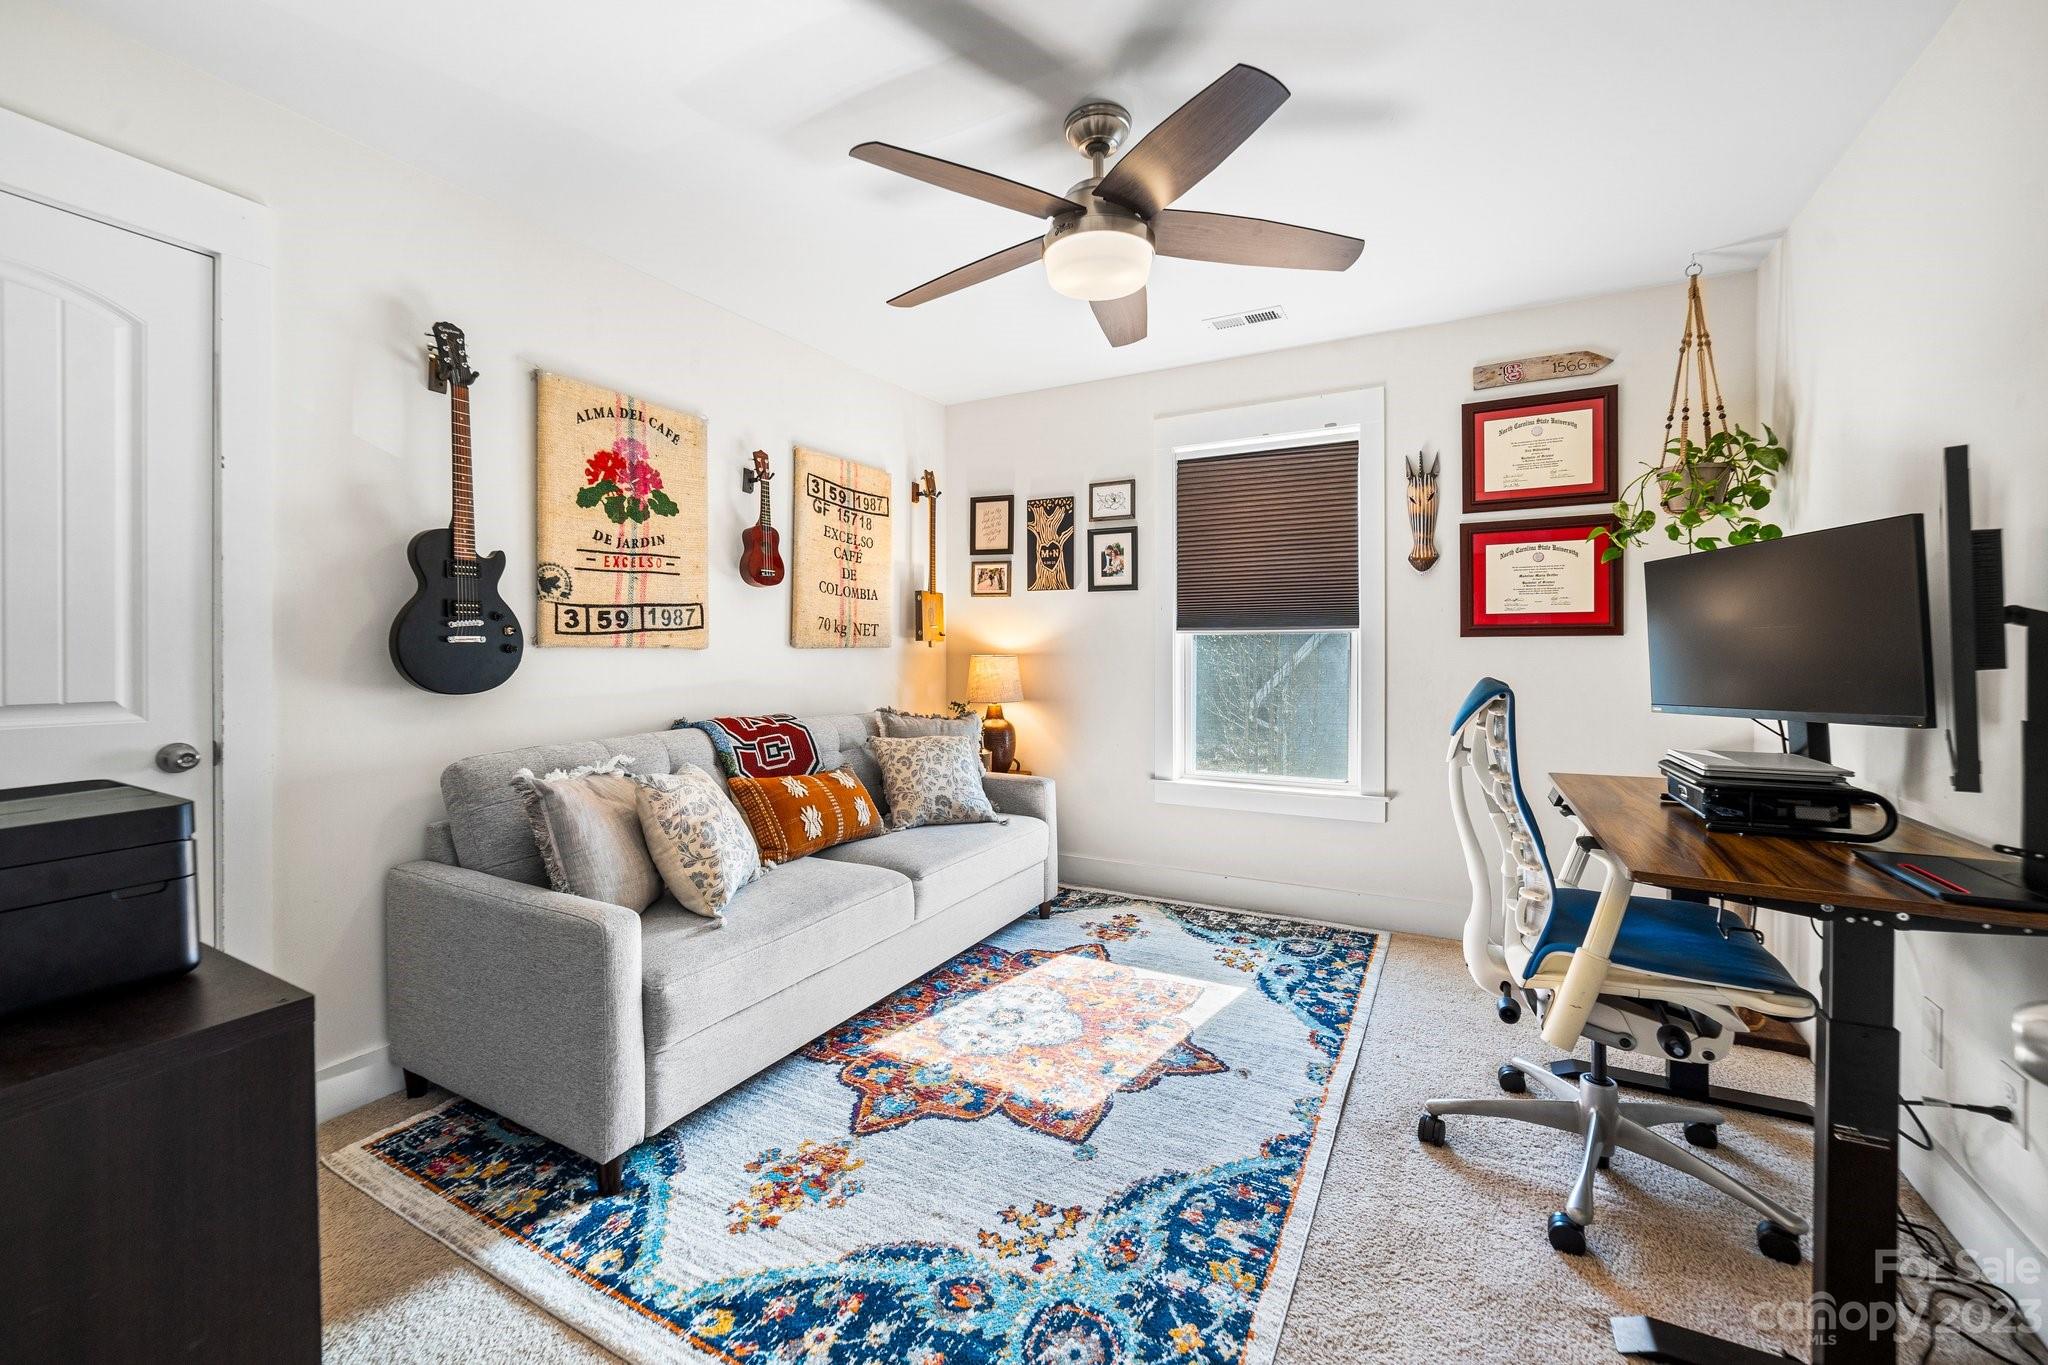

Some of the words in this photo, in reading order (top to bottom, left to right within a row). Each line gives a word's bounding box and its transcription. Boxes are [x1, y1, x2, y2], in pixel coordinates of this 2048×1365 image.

[576, 407, 614, 424] ALMA
[620, 407, 645, 423] DEL
[811, 479, 820, 494] 3
[829, 487, 846, 504] 59
[855, 495, 883, 511] 1987
[813, 497, 831, 518] GF
[837, 507, 872, 530] 15718
[592, 529, 613, 545] DE
[616, 534, 665, 549] JARDIN
[823, 525, 874, 549] EXCELSO
[604, 555, 662, 568] EXCELSO
[842, 568, 857, 581] DE
[819, 580, 879, 601] COLOMBIA
[564, 609, 580, 629] 3
[597, 609, 629, 629] 59
[648, 607, 695, 627] 1987
[817, 616, 831, 632] 70
[834, 618, 847, 638] kg
[853, 623, 880, 637] NET
